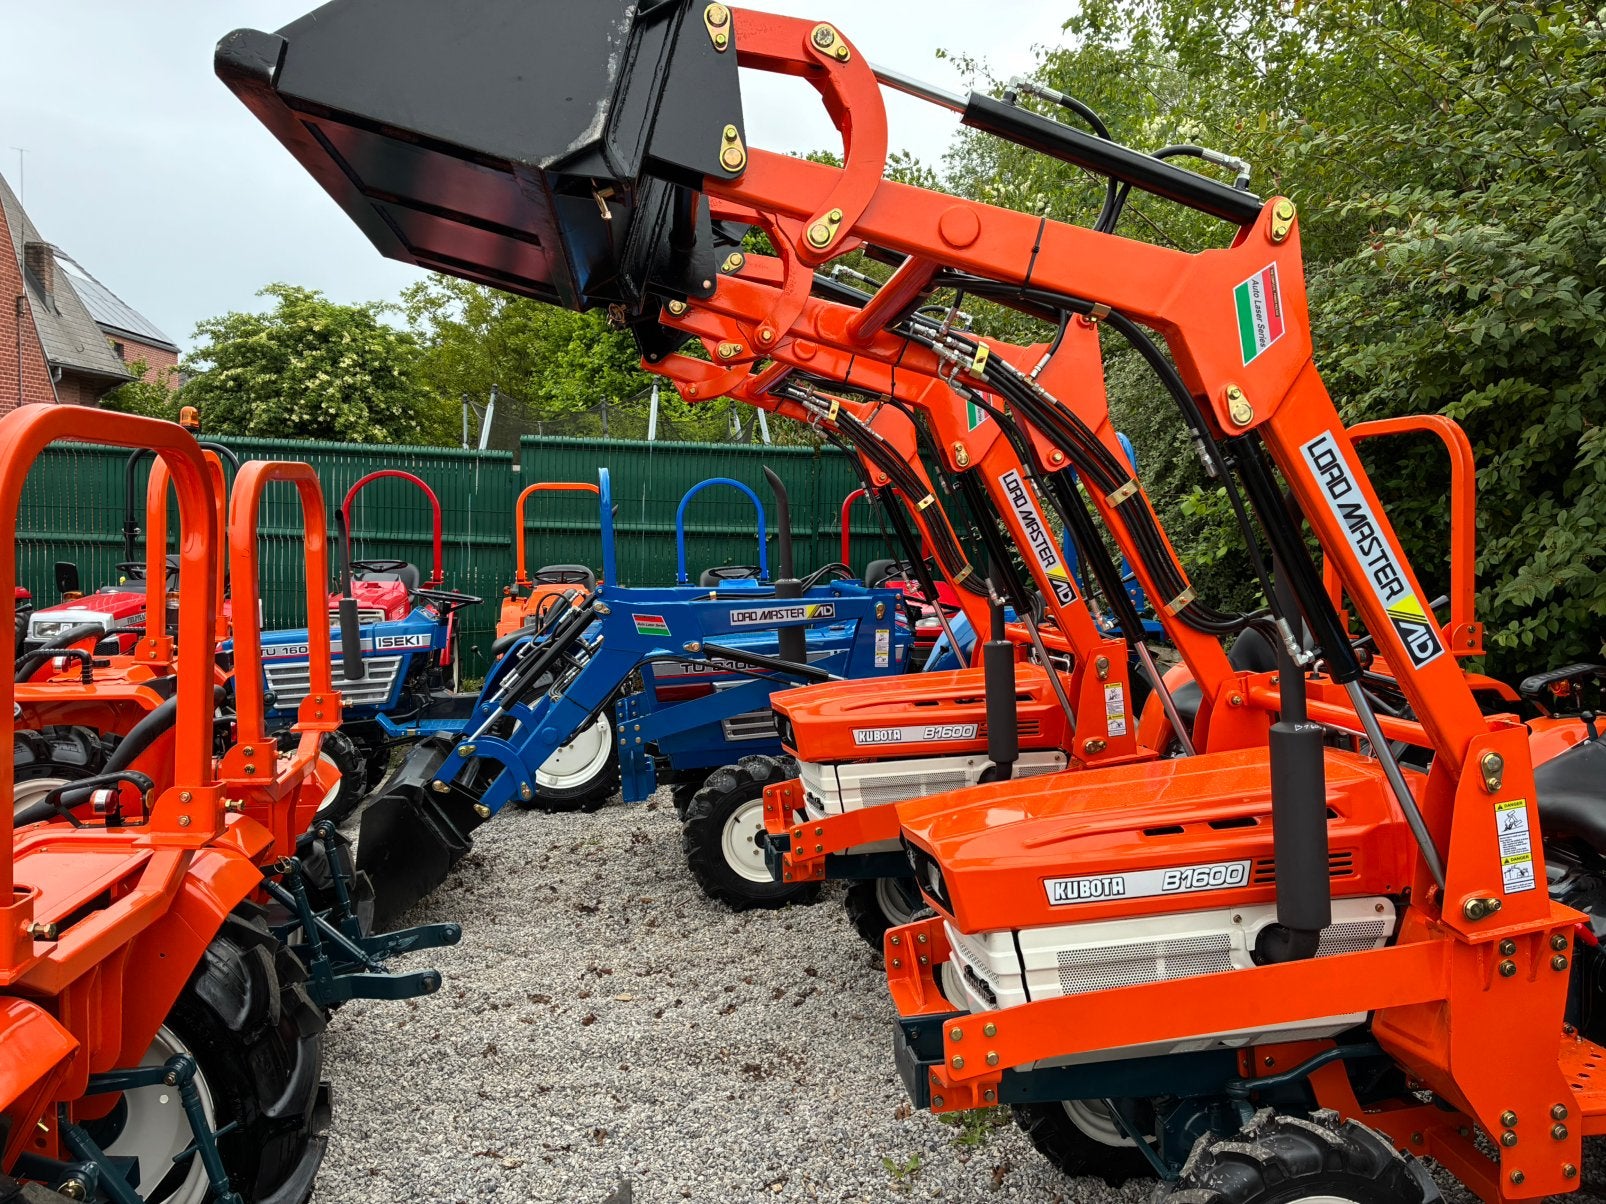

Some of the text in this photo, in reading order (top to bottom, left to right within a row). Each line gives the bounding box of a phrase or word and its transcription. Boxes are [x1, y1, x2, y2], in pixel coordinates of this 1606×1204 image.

[1251, 279, 1267, 348] Auto Laser Series
[1002, 471, 1028, 508] LOAD
[1018, 510, 1057, 568] MASTER
[1307, 436, 1352, 500] LOAD
[1337, 503, 1405, 601] MASTER
[731, 611, 757, 623] LOAD
[758, 607, 805, 621] MASTER
[378, 635, 420, 647] ISEKI
[680, 663, 706, 674] TU
[858, 725, 975, 742] KUBOTA B1600
[1054, 864, 1246, 901] KUBOTA B1600
